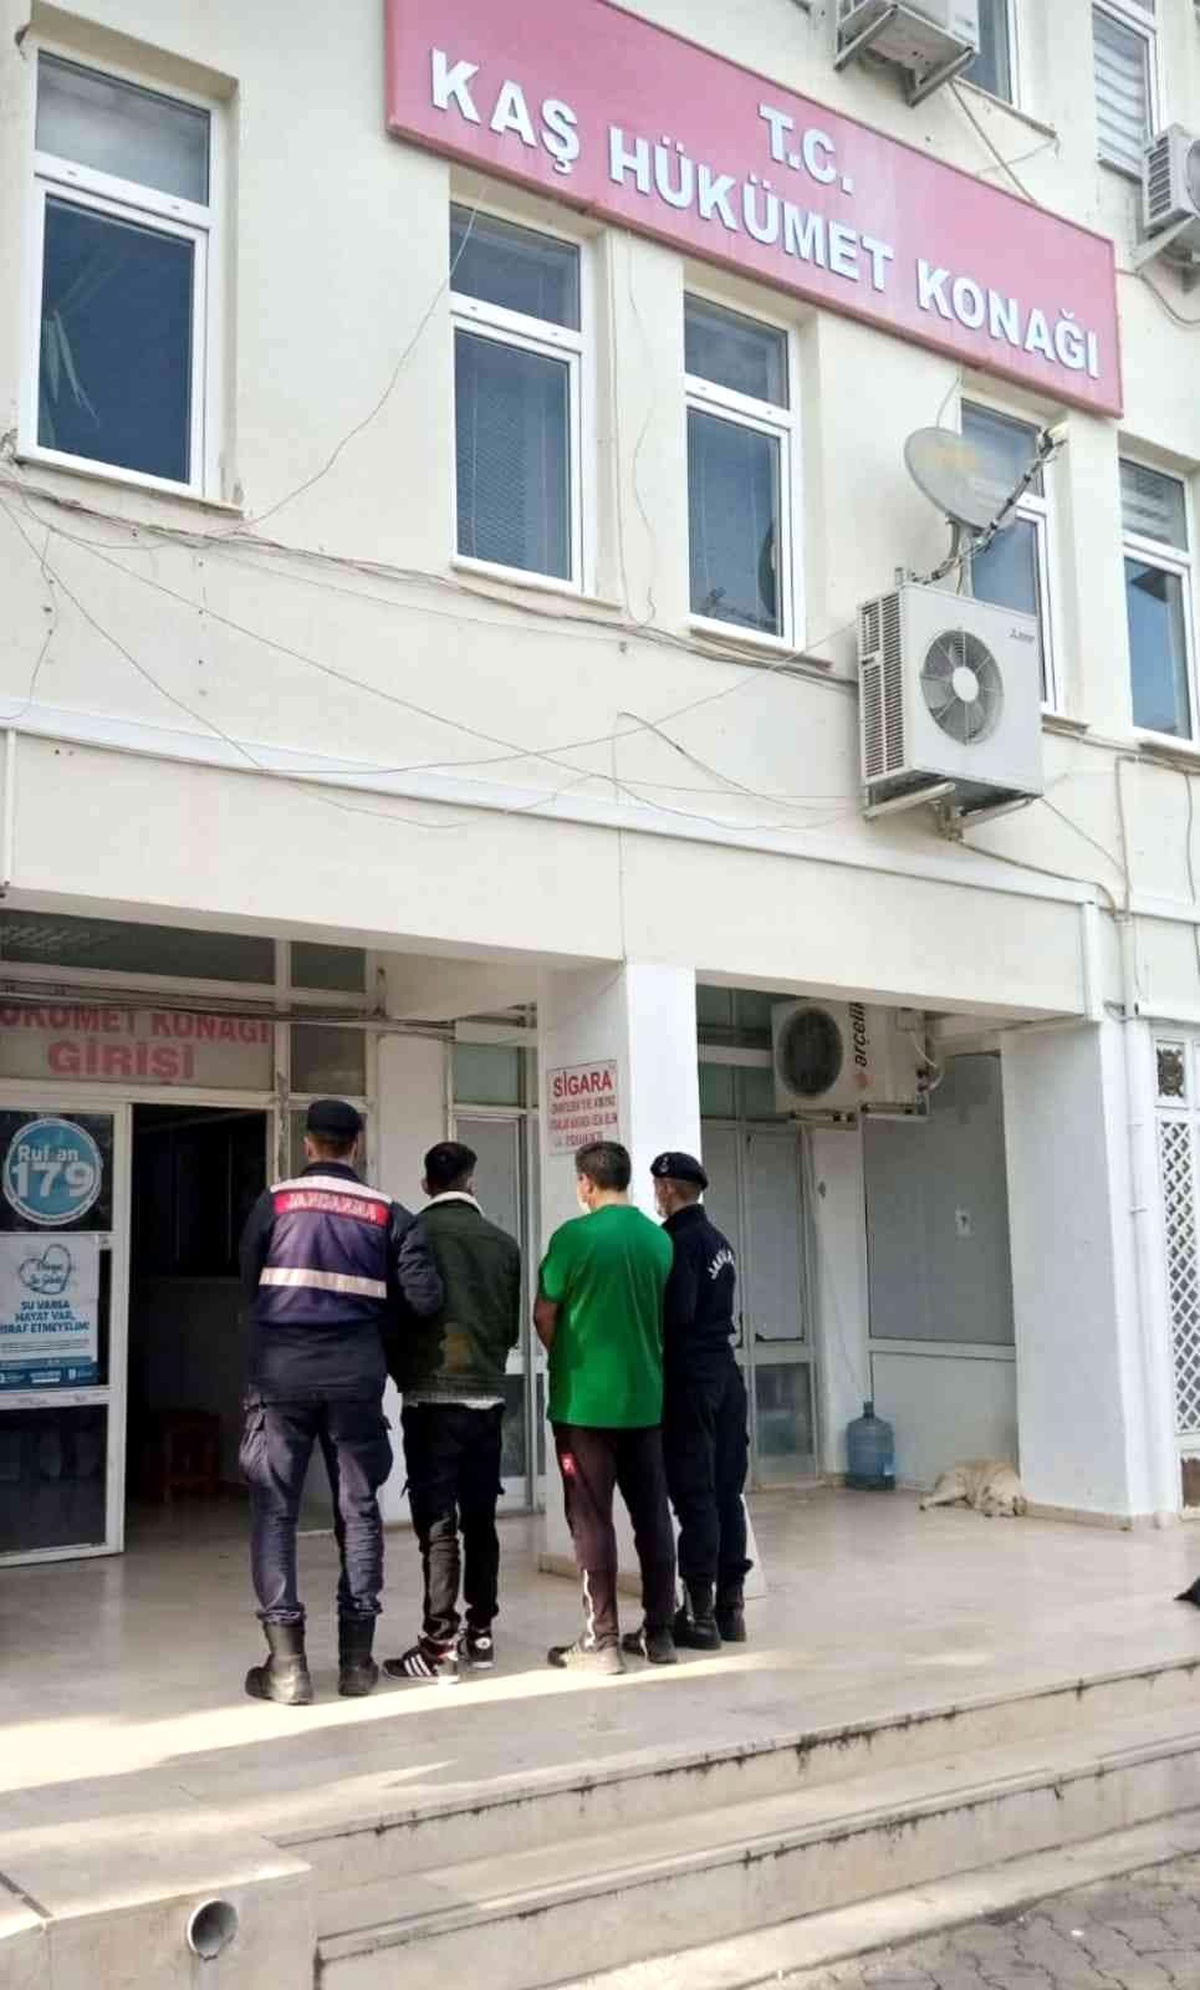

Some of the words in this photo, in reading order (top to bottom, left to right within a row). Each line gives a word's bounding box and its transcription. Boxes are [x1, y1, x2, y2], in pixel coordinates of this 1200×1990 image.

[757, 103, 854, 194] T.C.
[430, 48, 581, 175] KAŞ
[608, 127, 895, 291] HÜKÜMET
[916, 258, 1100, 380] KONAĞI
[553, 1070, 613, 1098] SİGARA
[11, 1161, 95, 1198] 179
